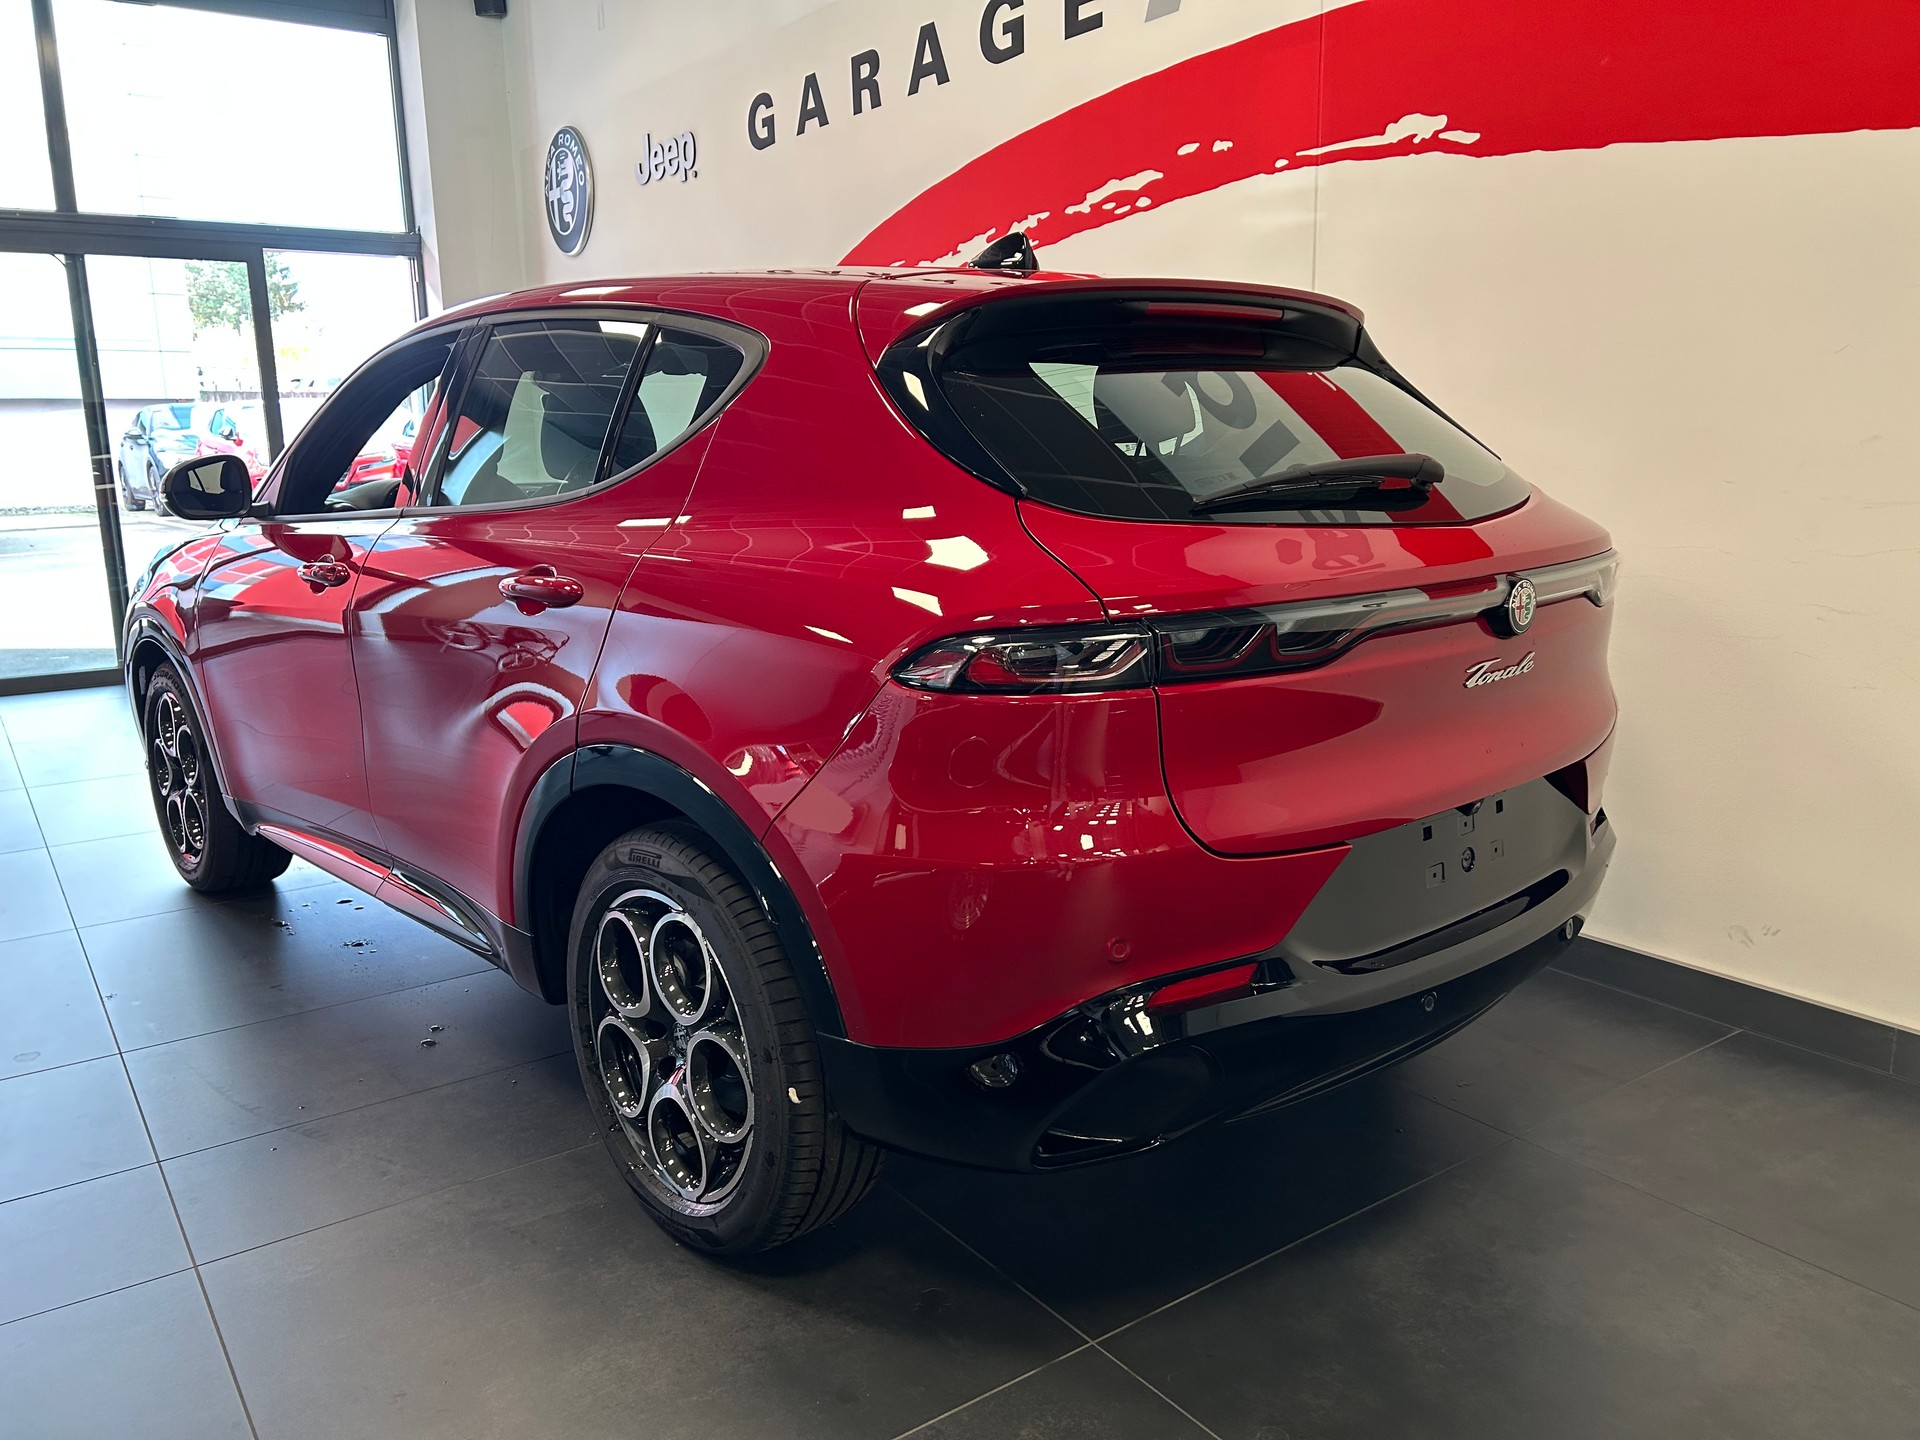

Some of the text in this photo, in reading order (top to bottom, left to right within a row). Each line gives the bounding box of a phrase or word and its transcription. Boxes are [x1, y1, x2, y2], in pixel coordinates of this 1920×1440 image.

[747, 0, 1104, 150] GARAGE
[558, 133, 585, 187] ROMEO
[1463, 651, 1535, 688] Tonale
[628, 848, 662, 868] PIRELLI
